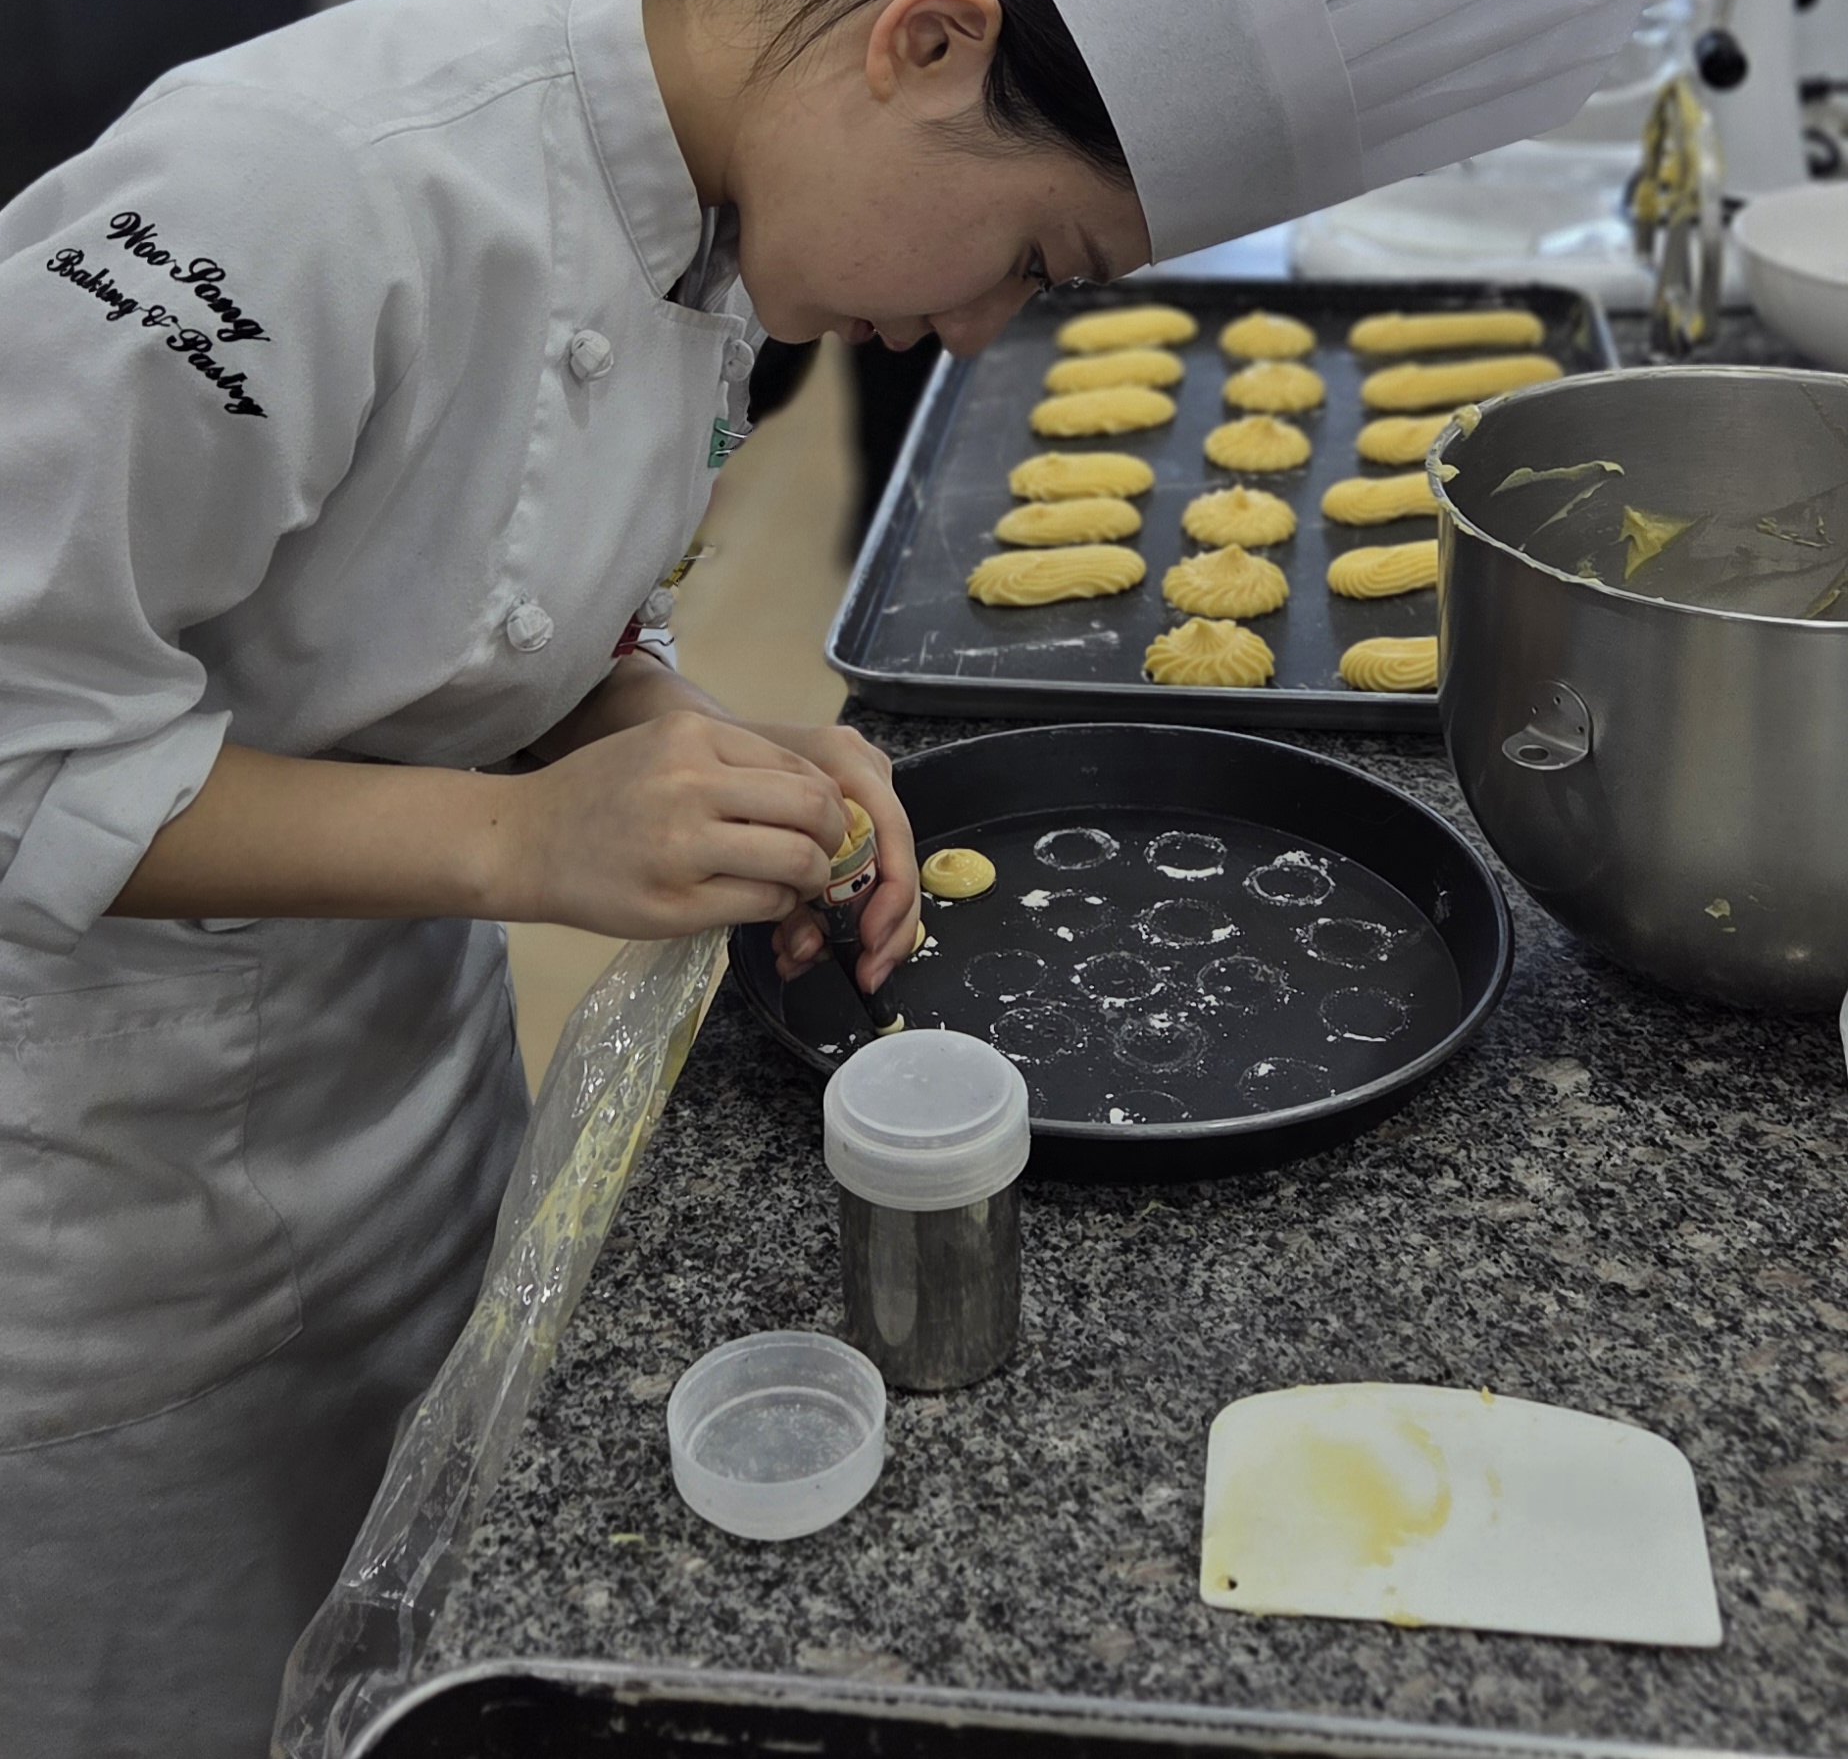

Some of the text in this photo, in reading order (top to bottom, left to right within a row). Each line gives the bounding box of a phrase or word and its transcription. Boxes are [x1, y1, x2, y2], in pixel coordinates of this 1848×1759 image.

[46, 248, 268, 419] Baking & Pastry
[106, 211, 271, 343] Woo Song
